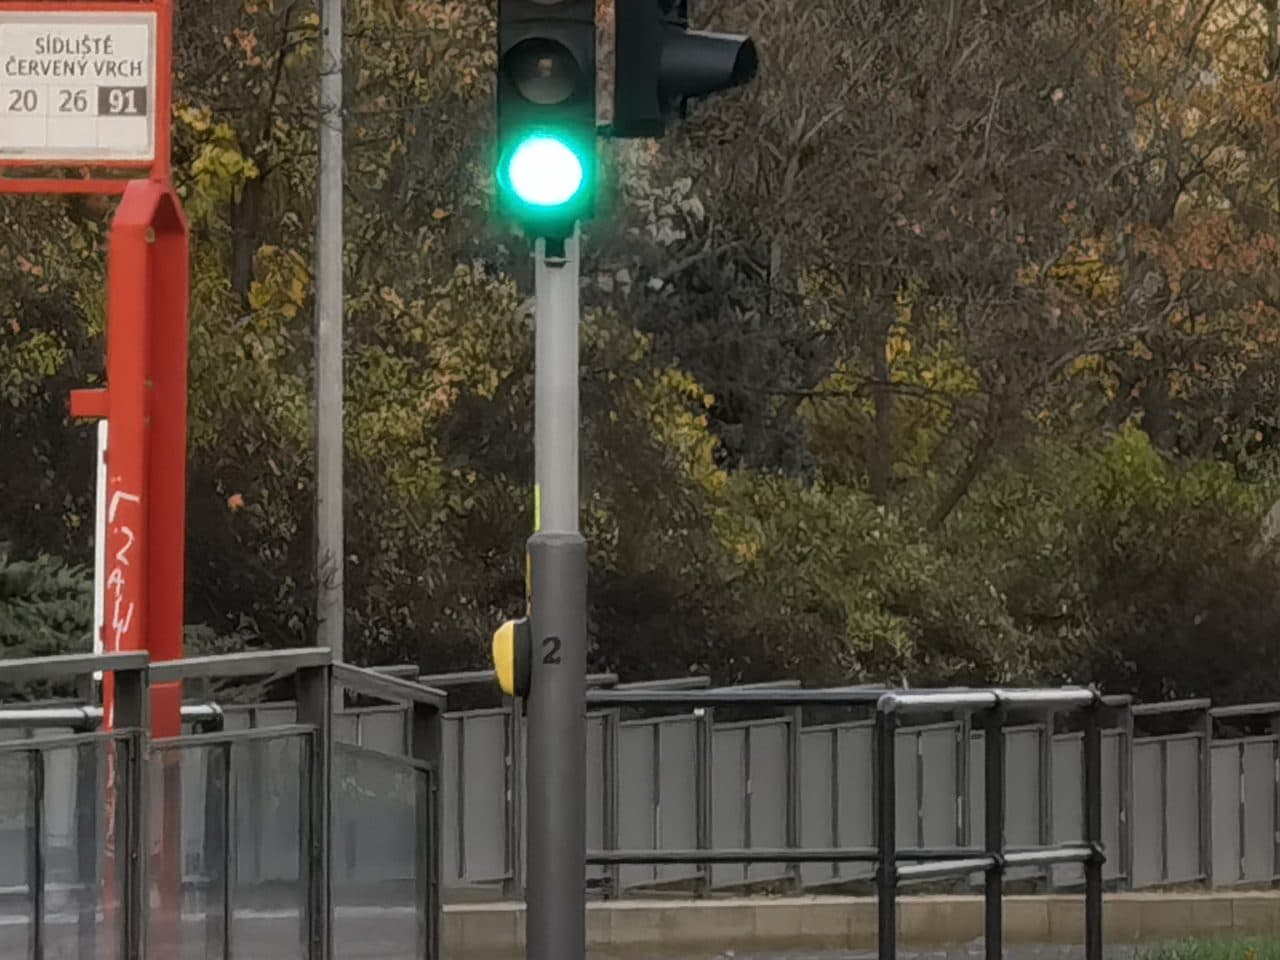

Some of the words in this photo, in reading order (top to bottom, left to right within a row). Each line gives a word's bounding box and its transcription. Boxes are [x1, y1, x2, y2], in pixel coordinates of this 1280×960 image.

[5, 54, 88, 76] ČERVENÝ
[93, 59, 143, 77] VRCH
[8, 88, 38, 112] 20
[58, 88, 88, 112] 26
[108, 88, 138, 113] 91
[542, 636, 561, 665] 2
